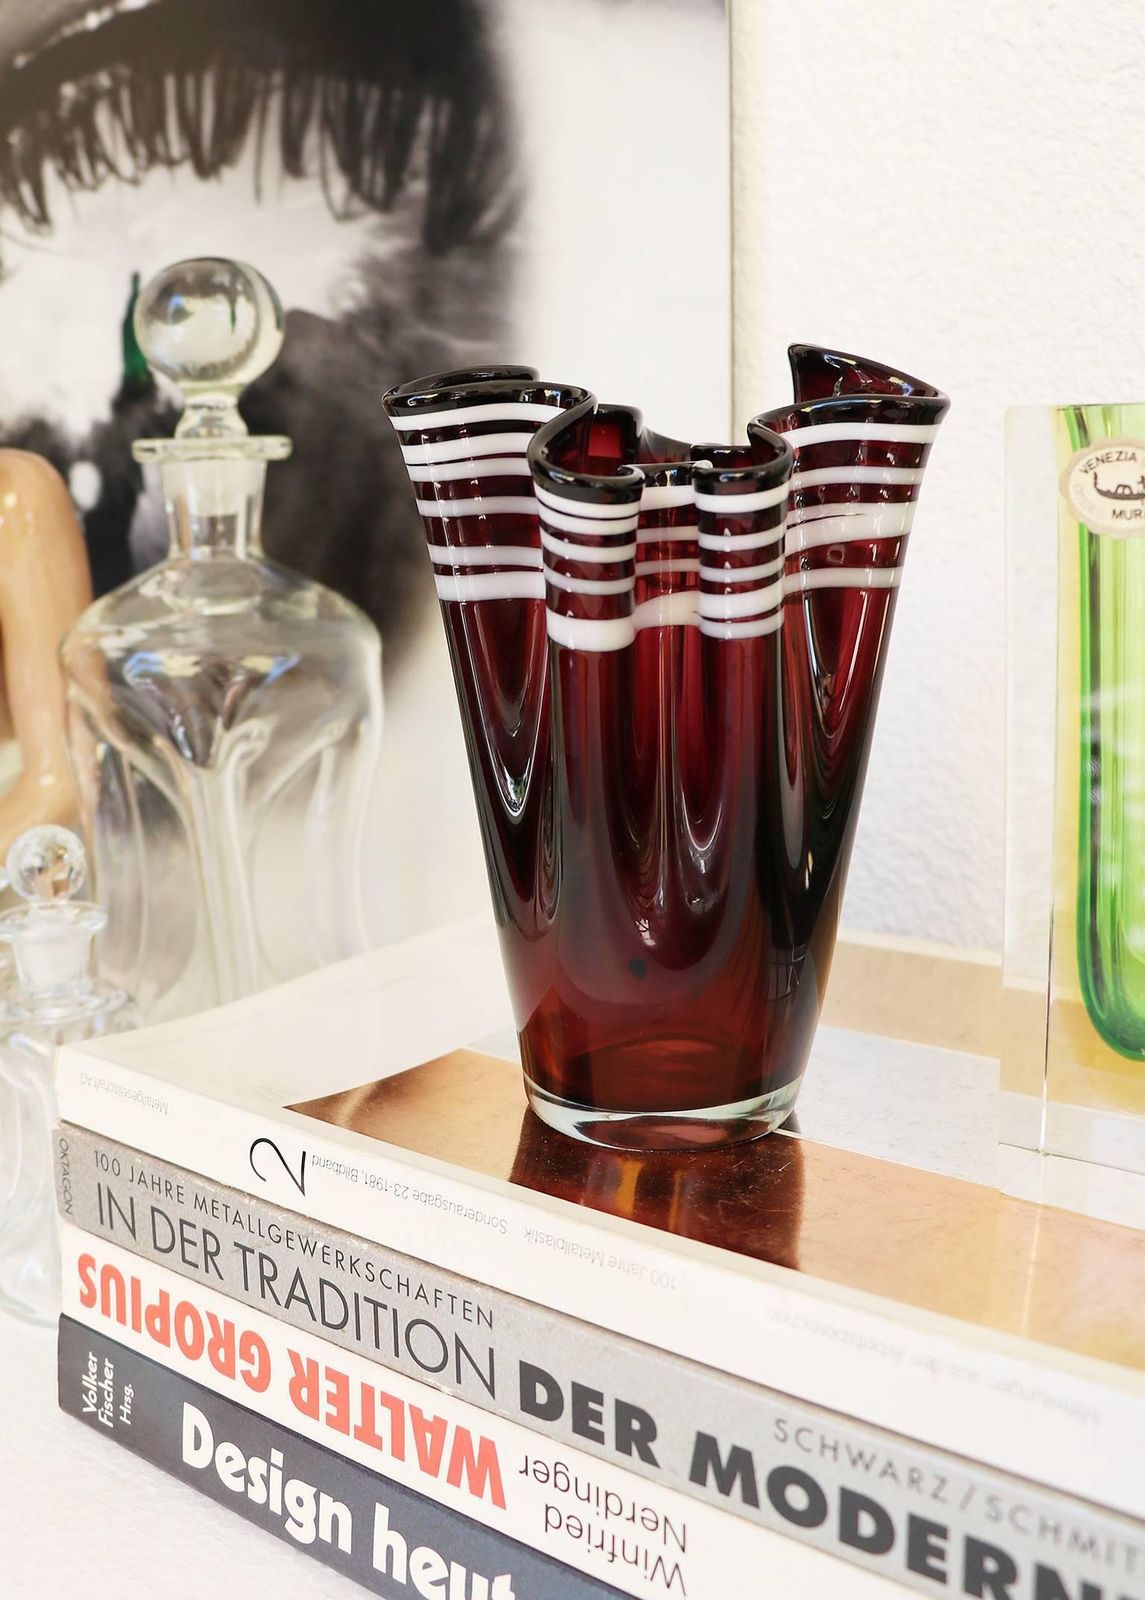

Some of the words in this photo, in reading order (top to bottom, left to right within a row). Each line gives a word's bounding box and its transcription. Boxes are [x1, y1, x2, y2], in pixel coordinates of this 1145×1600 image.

[1078, 450, 1137, 474] VENEZIA
[1111, 508, 1145, 521] MUR
[59, 1137, 74, 1216] OKTAGON
[311, 1154, 359, 1184] Bildband
[362, 1169, 410, 1202] 23-1981,
[93, 1149, 121, 1177] 100
[129, 1165, 185, 1205] JAHRE
[193, 1191, 494, 1330] METALLGEWERKSCHAFTEN
[412, 1188, 508, 1235] Sonderausgabe
[524, 1227, 606, 1268] Metallplastik
[607, 1253, 649, 1279] Jahre
[77, 1252, 272, 1394] GROPIUS
[81, 1351, 98, 1413] Volker
[96, 1182, 137, 1242] IN
[150, 1205, 225, 1281] DER
[233, 1240, 496, 1401] TRADITION
[518, 1359, 662, 1470] DER
[689, 1430, 1145, 1600] MODERN
[97, 1357, 114, 1428] Fischer
[119, 1383, 135, 1426] Hrsg.
[286, 1348, 507, 1511] WALTER
[181, 1400, 354, 1556] Design
[518, 1454, 687, 1554] Nerdinger
[544, 1503, 688, 1598] Winfried
